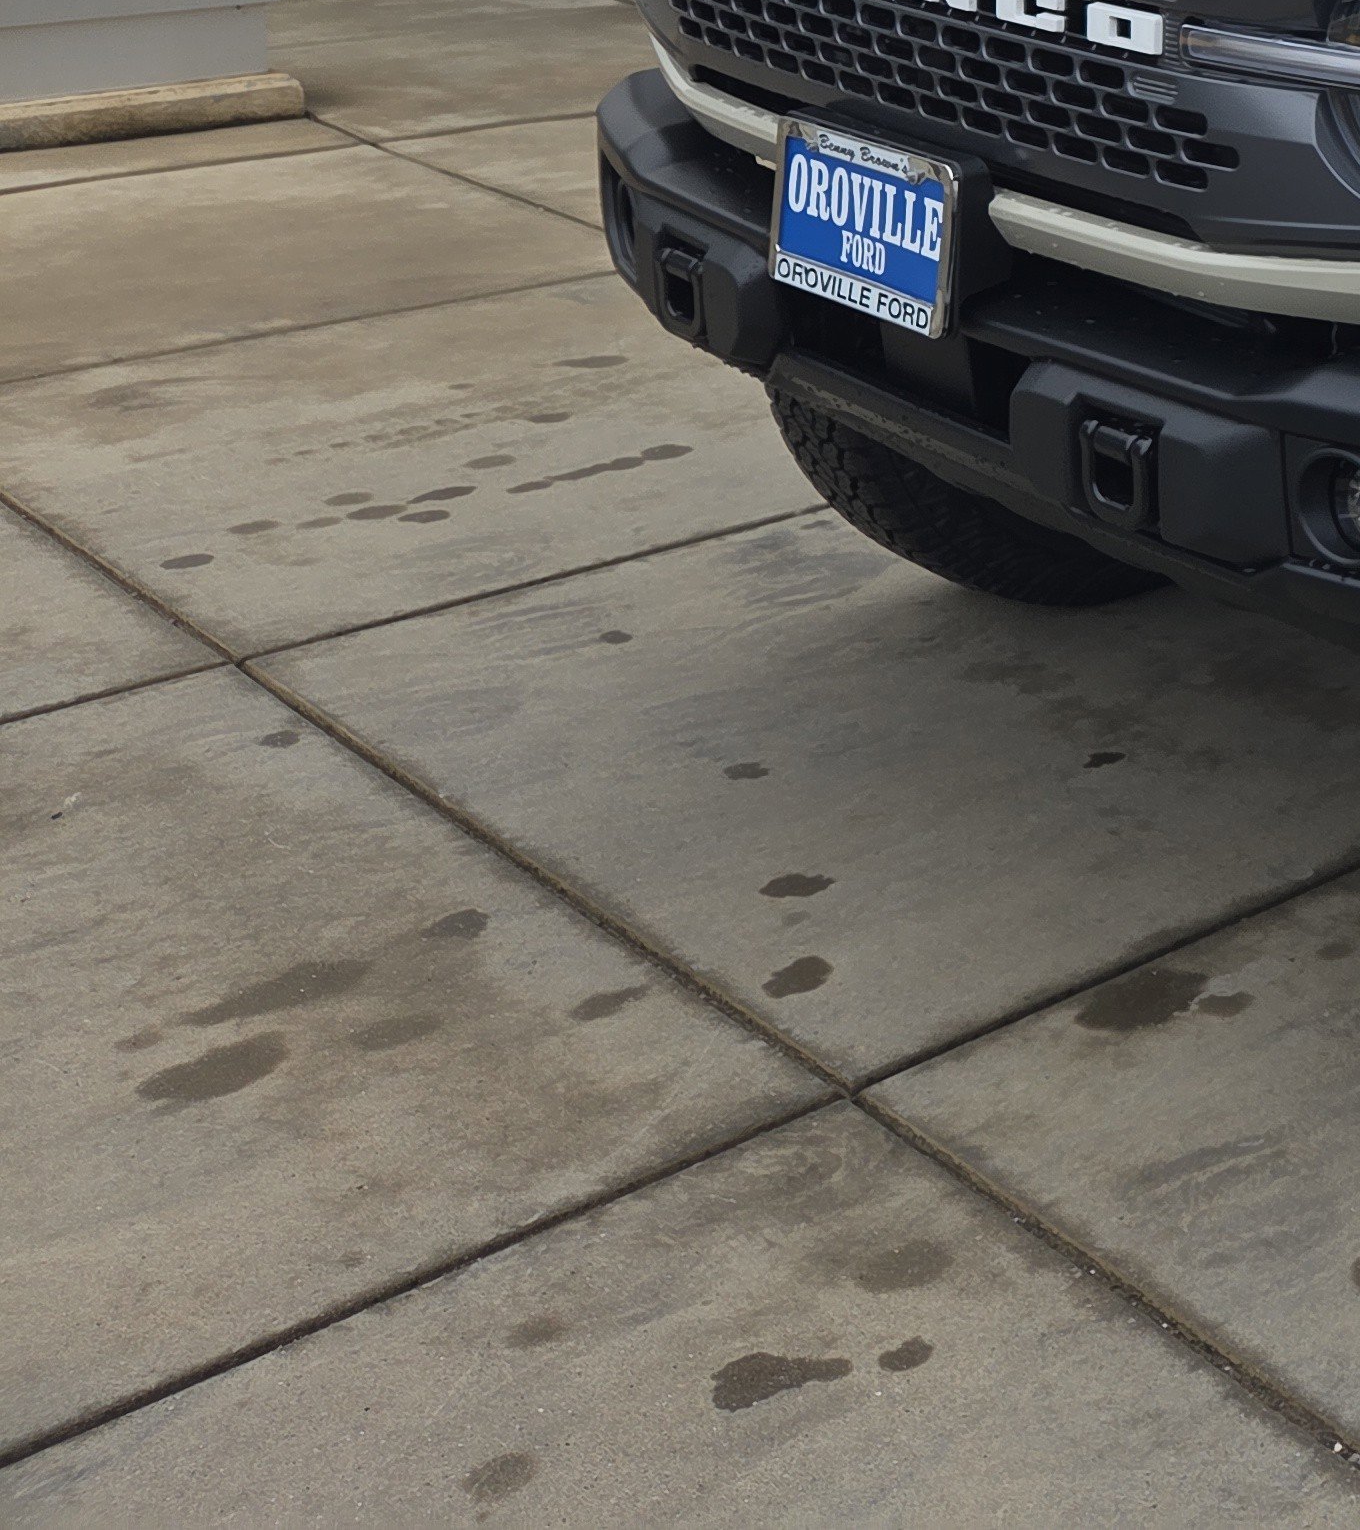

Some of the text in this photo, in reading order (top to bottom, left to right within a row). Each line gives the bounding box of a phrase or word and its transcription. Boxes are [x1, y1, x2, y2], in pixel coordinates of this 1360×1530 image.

[818, 133, 856, 162] Benny
[788, 153, 944, 262] OROVILLE
[840, 229, 886, 276] FORD
[777, 257, 929, 330] OROVILLE FORD
